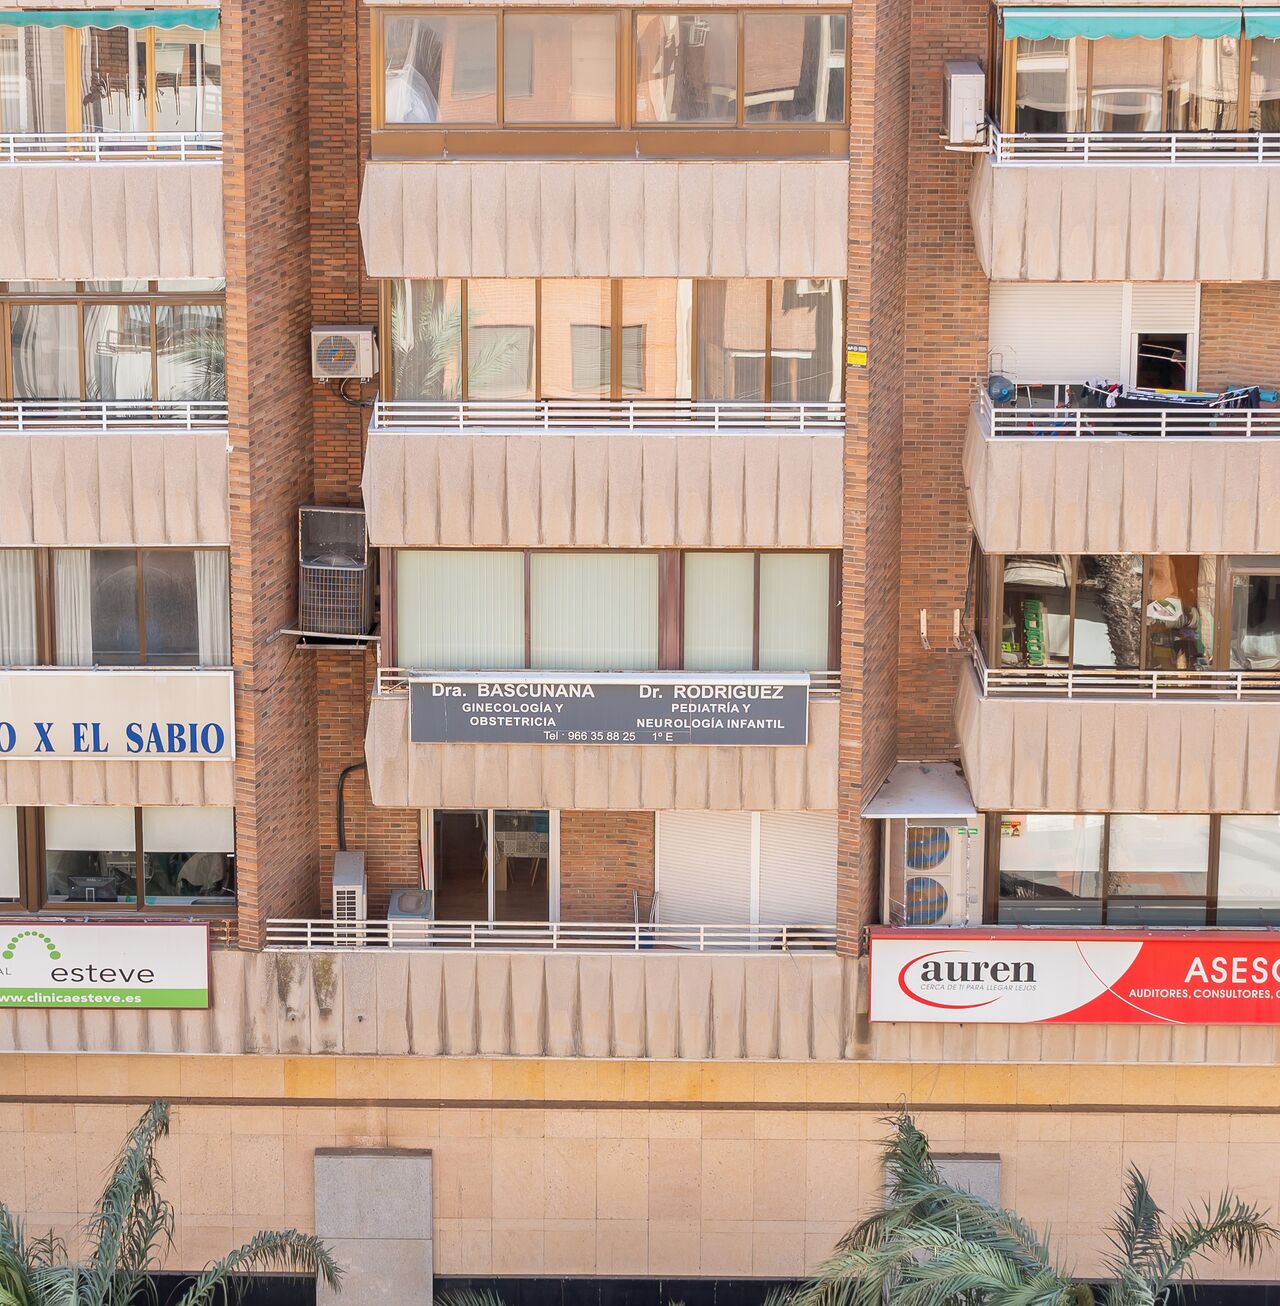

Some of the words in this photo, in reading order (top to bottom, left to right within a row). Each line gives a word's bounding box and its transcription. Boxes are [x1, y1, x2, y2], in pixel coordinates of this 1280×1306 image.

[432, 683, 467, 697] Dra.
[640, 685, 663, 699] Dr.
[462, 702, 553, 713] GINECOLOGÍA
[555, 704, 564, 713] Y
[671, 702, 740, 714] PEDIATRÍA
[742, 704, 751, 714] Y
[470, 717, 556, 727] OBSTETRICIA
[636, 717, 724, 729] NEUROLOGÍA
[726, 719, 785, 729] INFANTIL
[34, 723, 55, 752] X
[73, 723, 109, 753] EL
[126, 722, 225, 754] SABIO
[568, 731, 589, 741] 966
[590, 732, 604, 741] 35
[606, 732, 620, 741] 88
[622, 732, 636, 742] 25
[665, 732, 673, 742] E
[50, 963, 155, 984] esteve
[920, 955, 1037, 983] auren
[1129, 988, 1191, 1001] AUDITORES,
[1193, 989, 1274, 1001] CONSULTORES,
